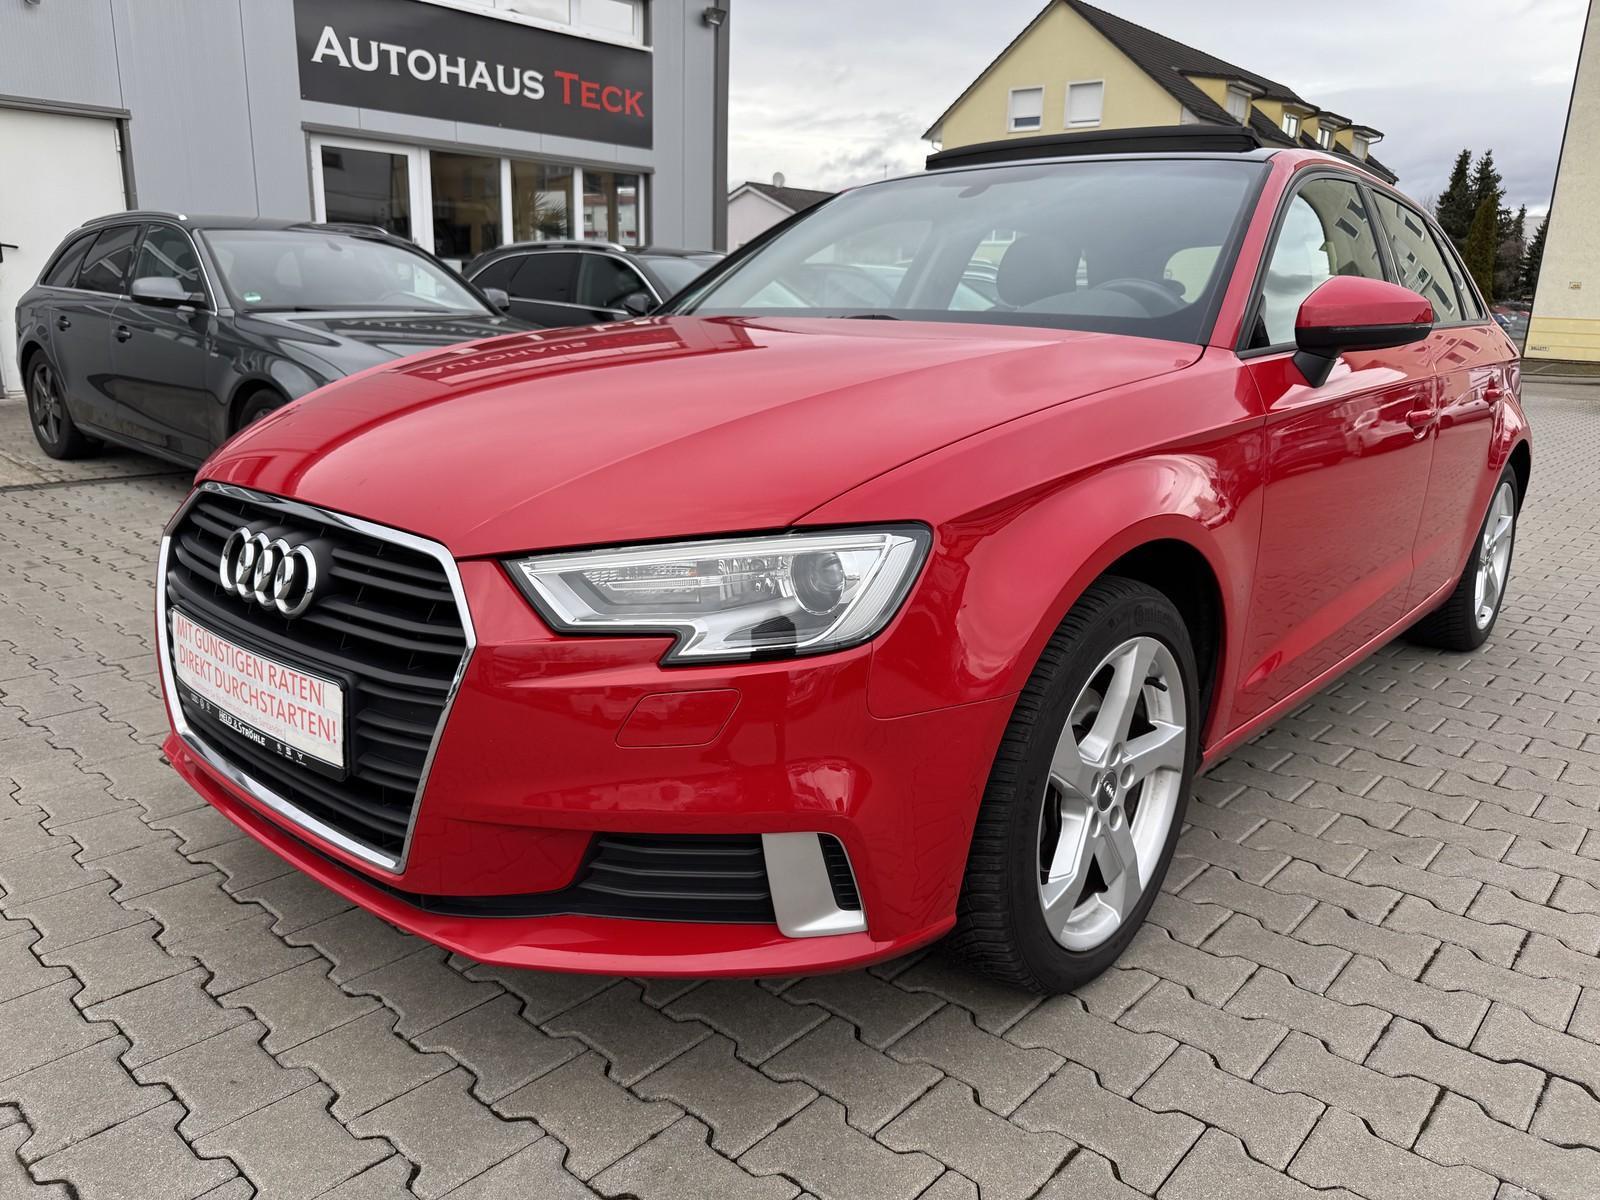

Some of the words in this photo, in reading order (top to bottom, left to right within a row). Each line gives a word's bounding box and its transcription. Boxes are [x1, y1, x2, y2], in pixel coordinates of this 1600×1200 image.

[310, 25, 545, 101] AUTOHAUS
[554, 70, 645, 118] TECK
[177, 615, 193, 642] MIT
[269, 664, 322, 706] RATEN
[179, 644, 212, 682] DIREKT
[214, 666, 337, 744] DURCHSTARTEN!
